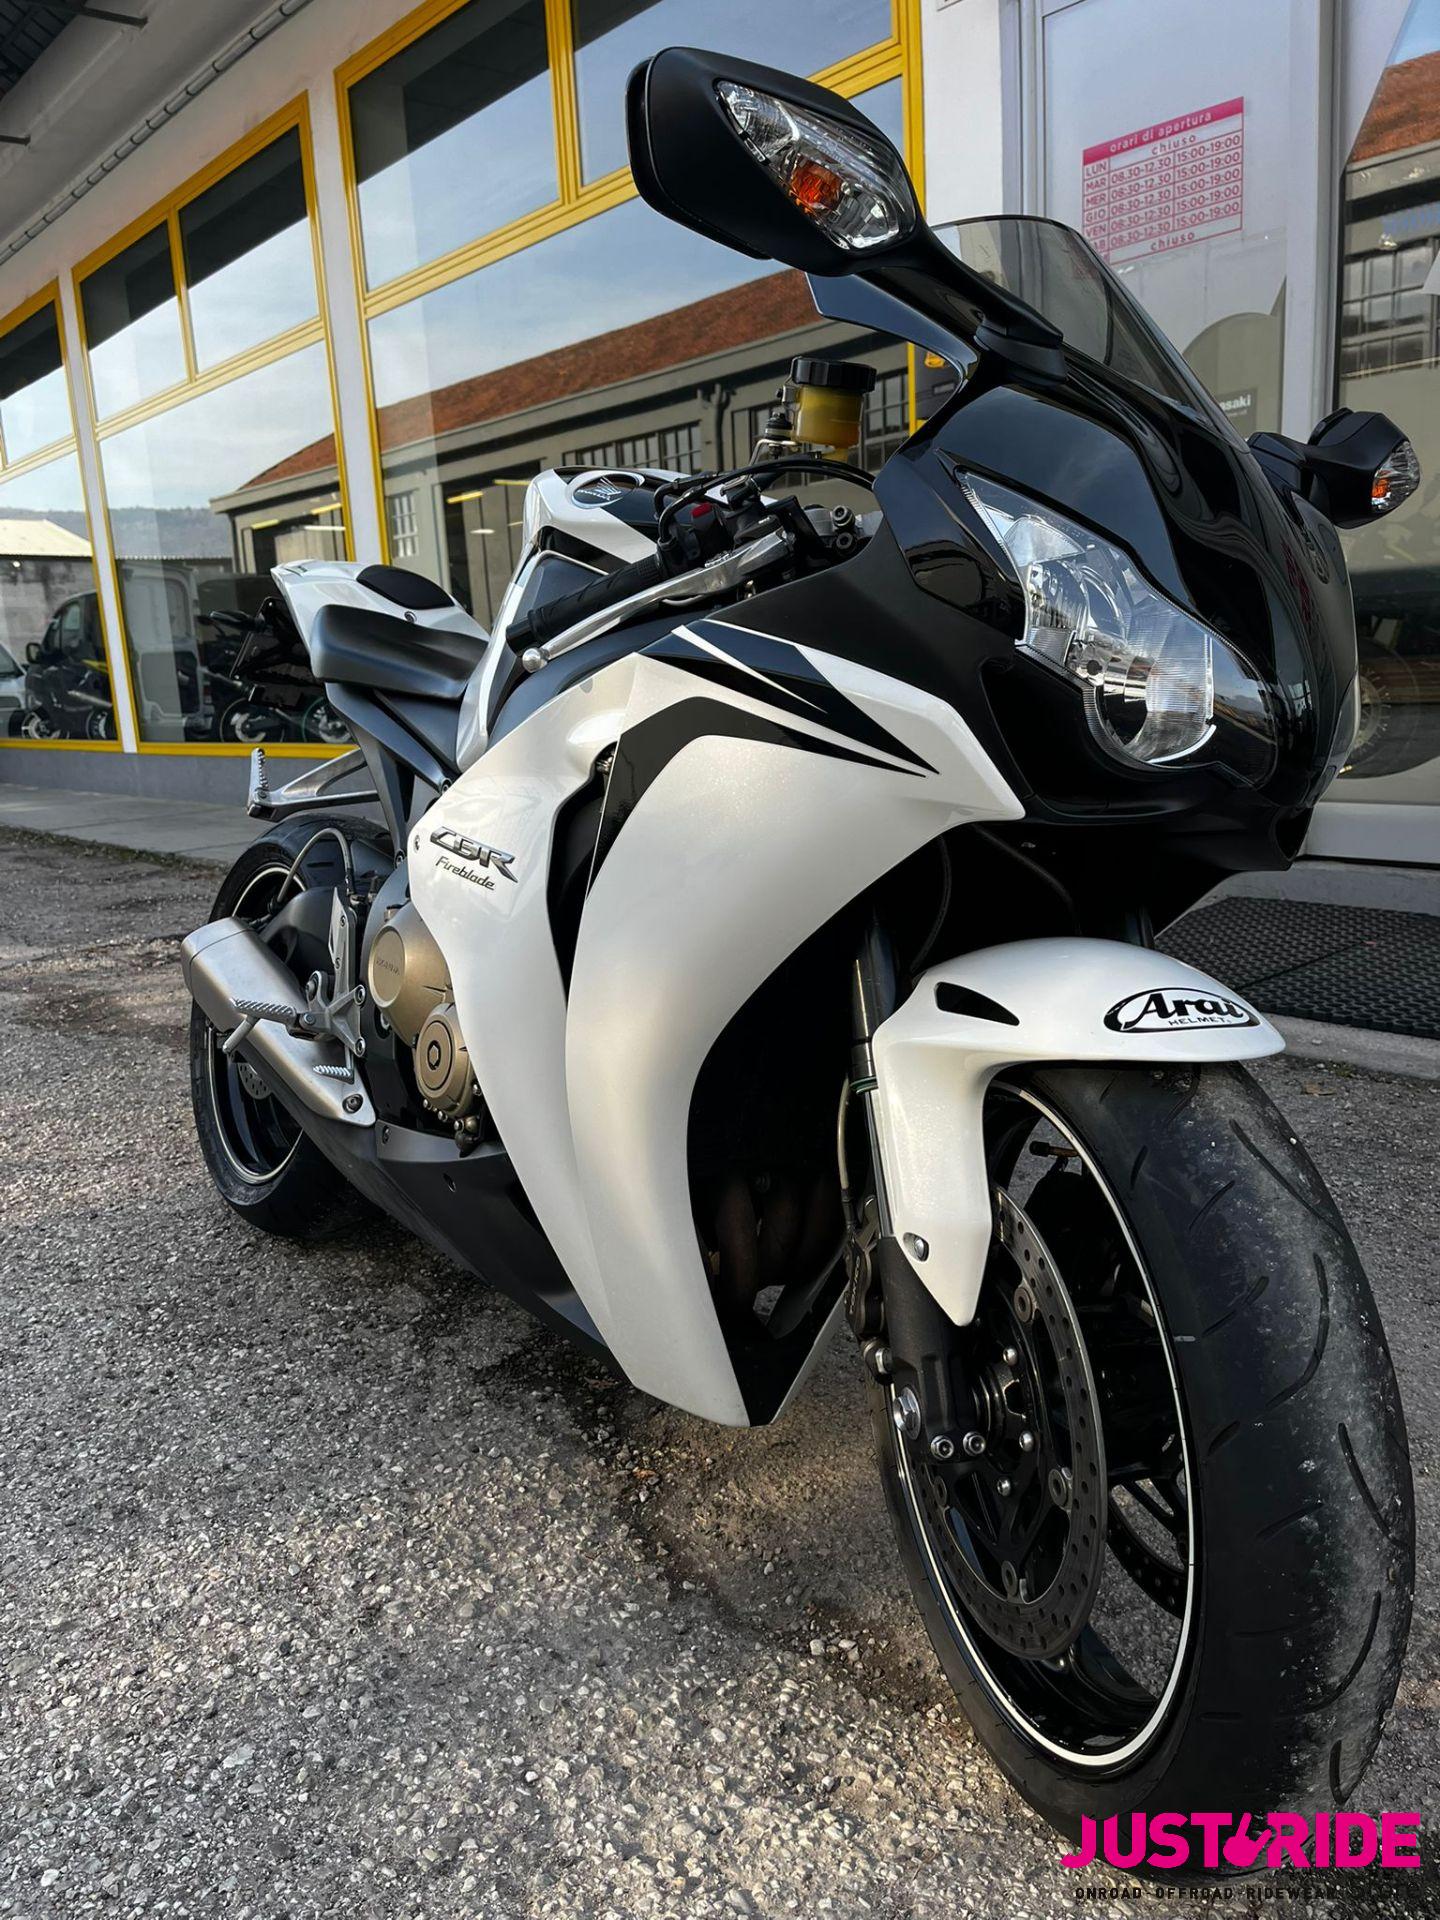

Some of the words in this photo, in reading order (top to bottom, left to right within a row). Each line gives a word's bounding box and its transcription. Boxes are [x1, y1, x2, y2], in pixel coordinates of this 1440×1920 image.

[1110, 136, 1138, 153] orari
[1142, 130, 1154, 142] di
[1158, 112, 1212, 137] apertura
[1085, 161, 1107, 177] LUN
[1151, 135, 1197, 155] chiuso
[1086, 177, 1107, 192] MAR
[1086, 193, 1107, 208] MER
[1086, 208, 1106, 222] GIO
[1085, 224, 1107, 237] VEN
[1150, 232, 1195, 251] chiuso
[430, 826, 518, 883] CBR
[435, 855, 495, 891] Fireblade
[1121, 992, 1244, 1030] Arai
[1168, 1017, 1225, 1026] HELMET
